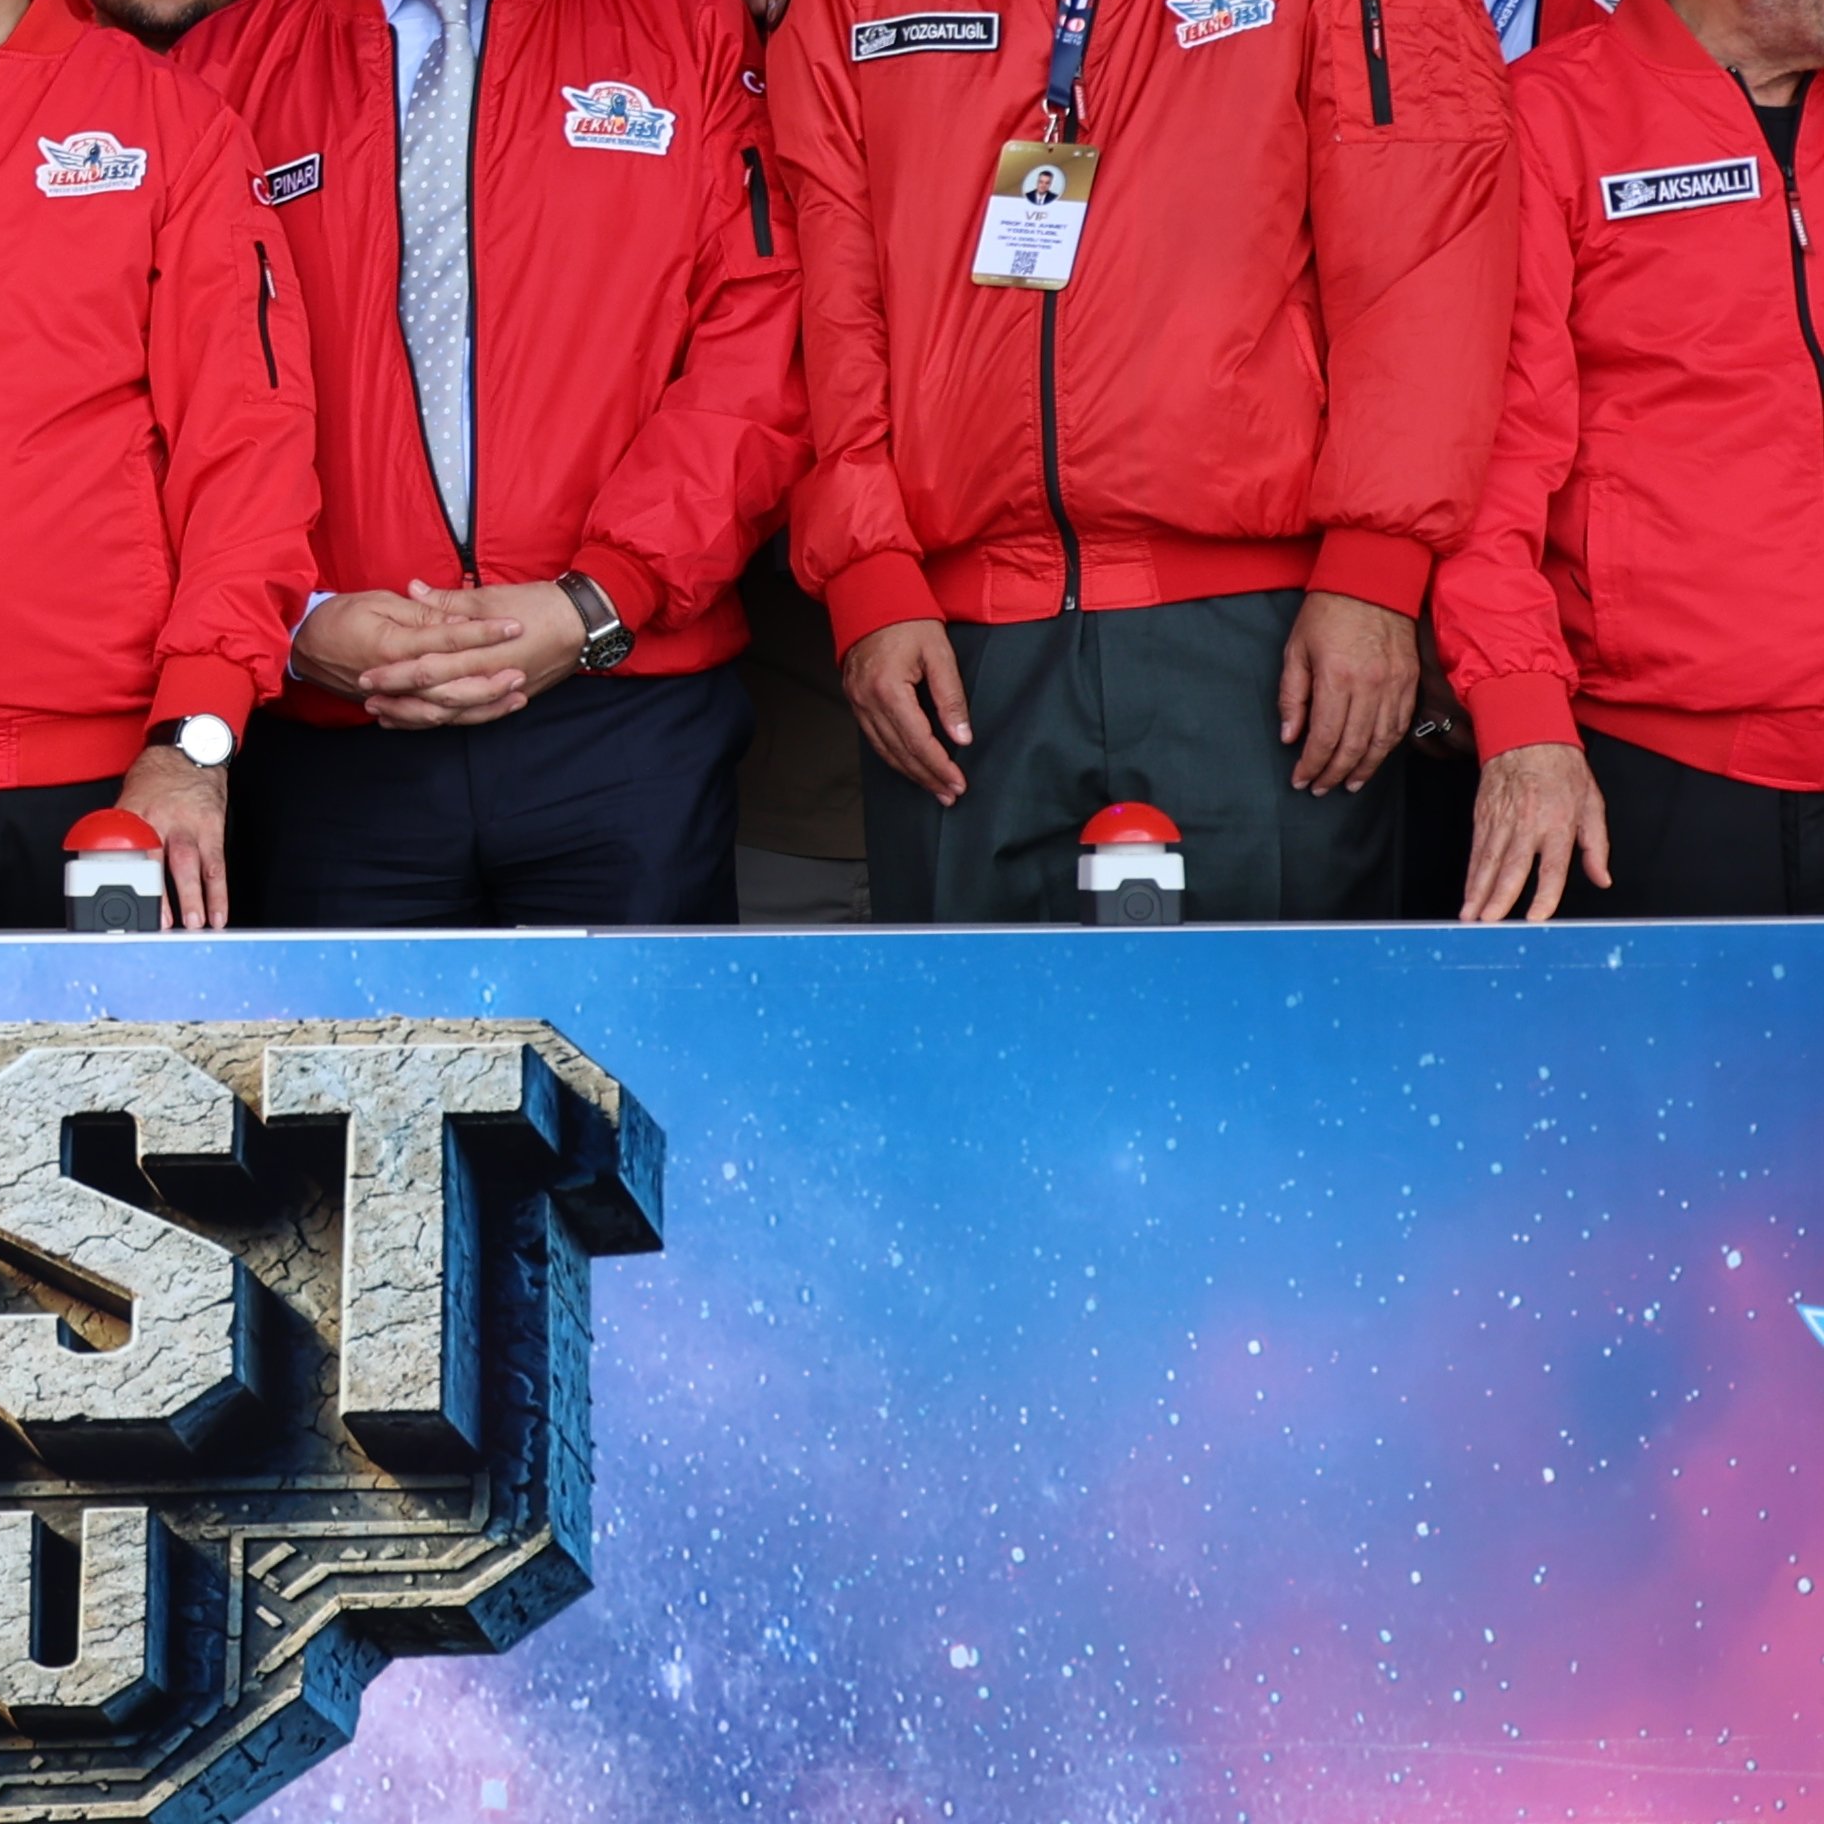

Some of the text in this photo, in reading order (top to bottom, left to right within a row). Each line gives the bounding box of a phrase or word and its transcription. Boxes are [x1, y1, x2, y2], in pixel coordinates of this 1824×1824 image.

[1179, 2, 1272, 44] TEKNOFEST
[572, 116, 666, 141] TEKNOFEST
[47, 161, 140, 185] TEKNOFEST
[270, 165, 315, 198] PINAR
[1657, 168, 1751, 202] AKSAKALLI
[1025, 210, 1049, 222] VIP
